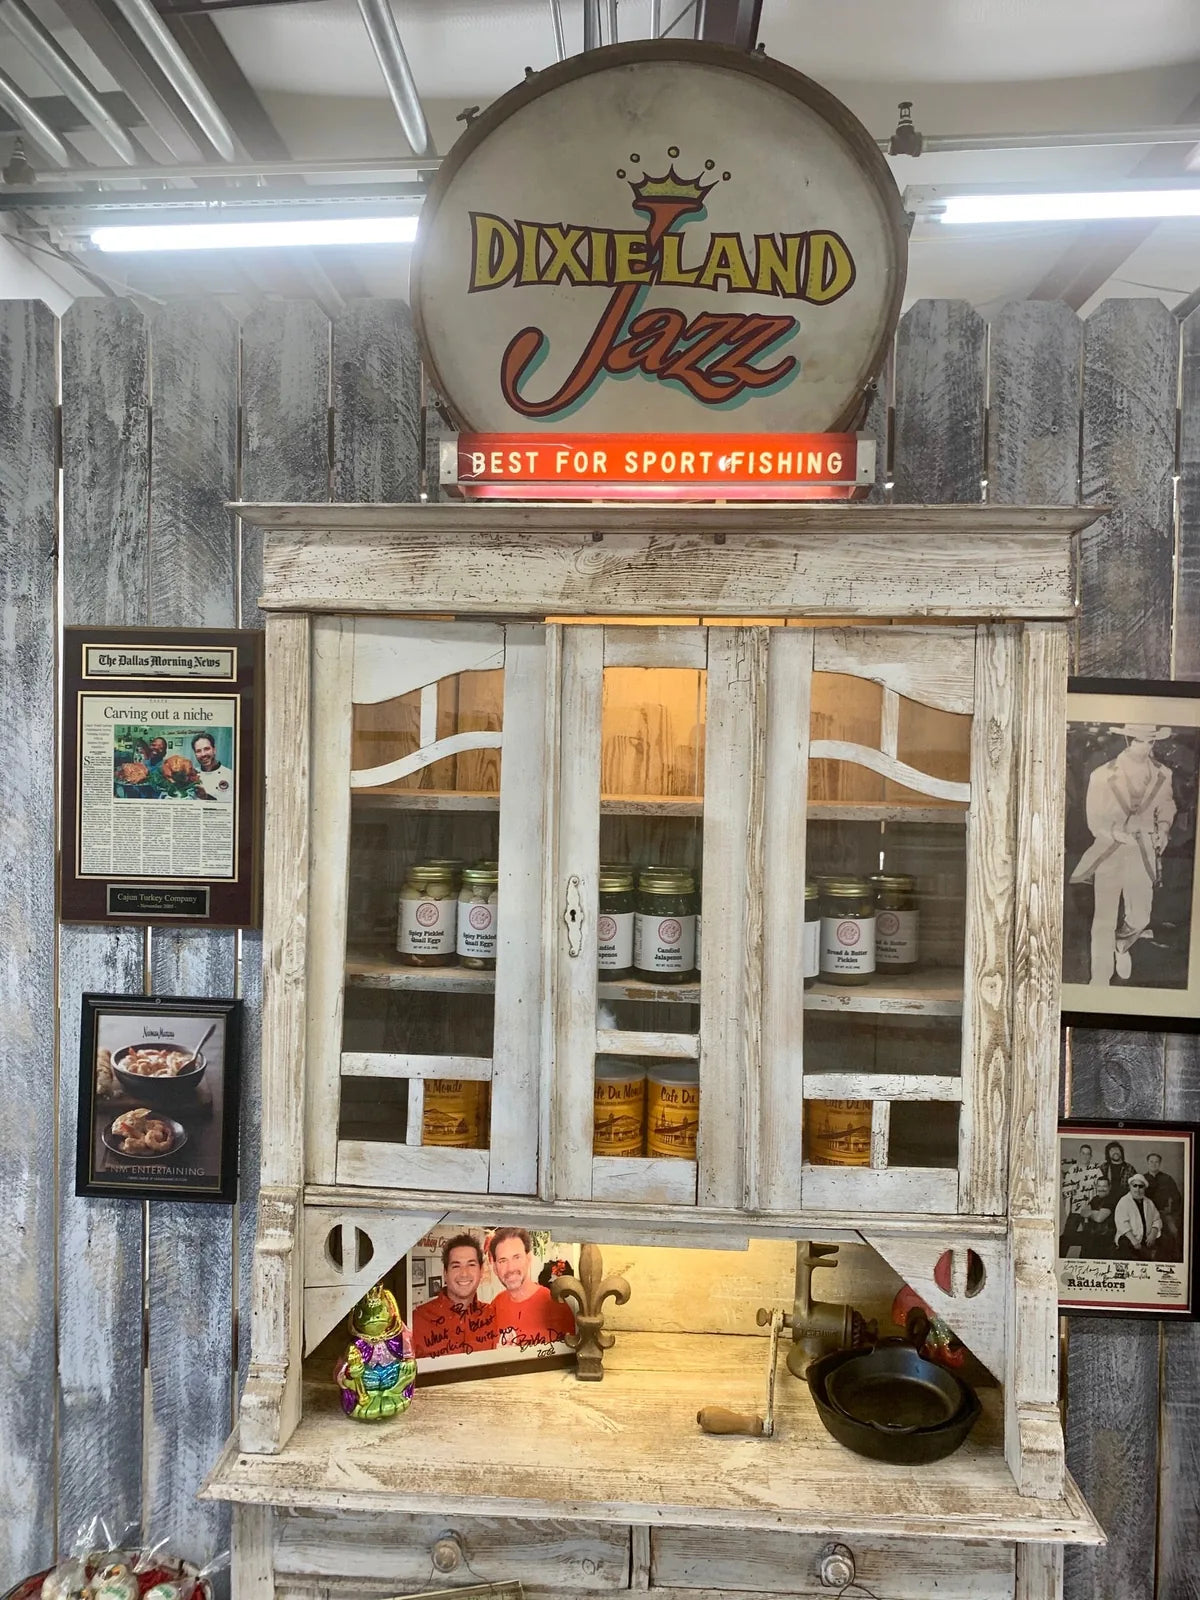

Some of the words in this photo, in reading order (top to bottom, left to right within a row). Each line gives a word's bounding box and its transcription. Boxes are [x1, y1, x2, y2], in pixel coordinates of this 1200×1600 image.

[468, 211, 856, 305] DIXIELAND
[500, 200, 800, 422] Jazz
[472, 451, 539, 474] BEST
[556, 451, 608, 474] FOR
[625, 451, 713, 474] SPORT
[730, 451, 843, 474] FISHING
[99, 655, 116, 667] The
[118, 655, 149, 666] Dallas
[150, 656, 193, 668] Morning
[194, 656, 221, 668] News
[104, 706, 148, 722] Carving
[151, 709, 169, 720] out
[173, 711, 180, 720] a
[183, 708, 214, 721] niche
[117, 893, 138, 902] Cajun
[139, 893, 162, 903] Turkey
[164, 894, 197, 904] Company
[408, 930, 422, 938] Spicy
[463, 932, 475, 940] Spicy
[608, 1085, 621, 1100] Du
[661, 1086, 679, 1104] Cafe
[682, 1089, 696, 1104] Du
[132, 1165, 205, 1176] ENTERTAINING
[1067, 1279, 1126, 1289] Radiators
[424, 1328, 449, 1347] What
[456, 1325, 464, 1335] a
[475, 1330, 499, 1343] with
